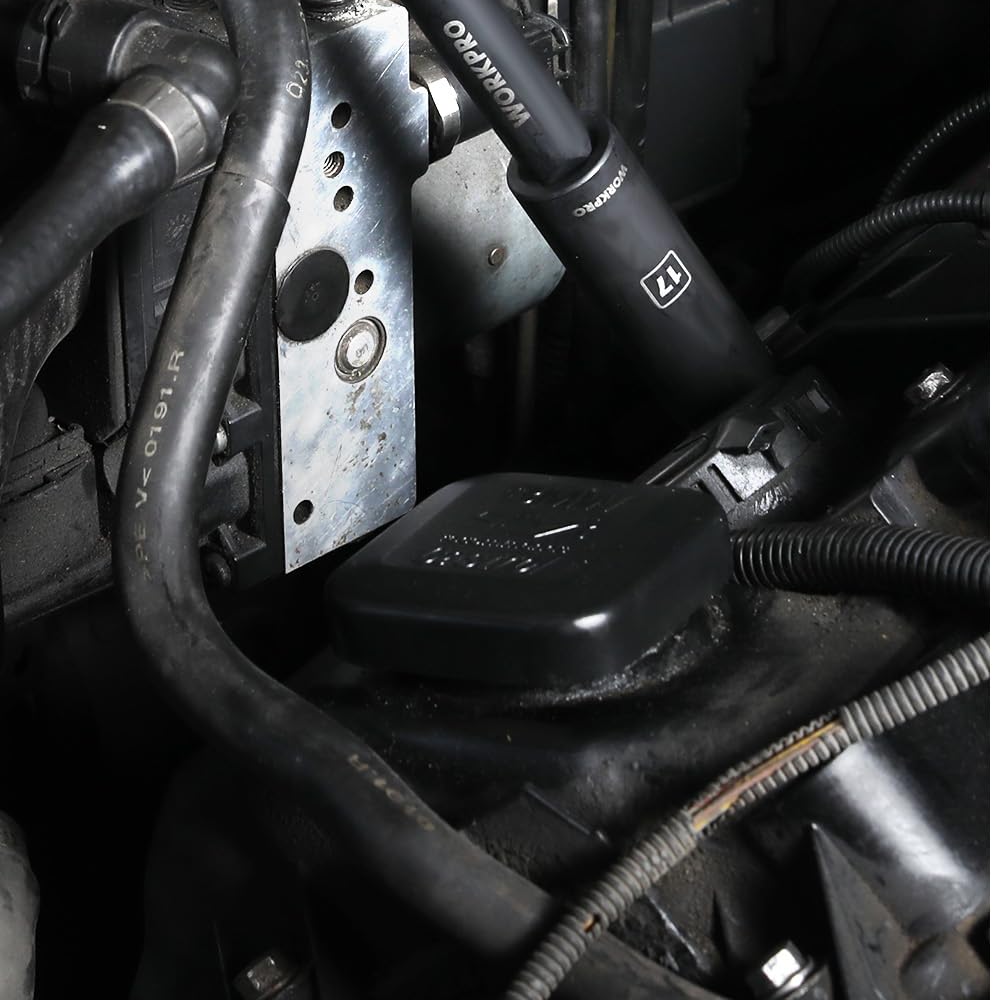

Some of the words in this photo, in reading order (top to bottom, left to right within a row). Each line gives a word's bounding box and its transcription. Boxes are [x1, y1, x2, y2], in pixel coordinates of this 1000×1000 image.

[443, 20, 532, 129] WORKPRO
[572, 164, 628, 217] WORKPRO
[656, 265, 682, 298] 17
